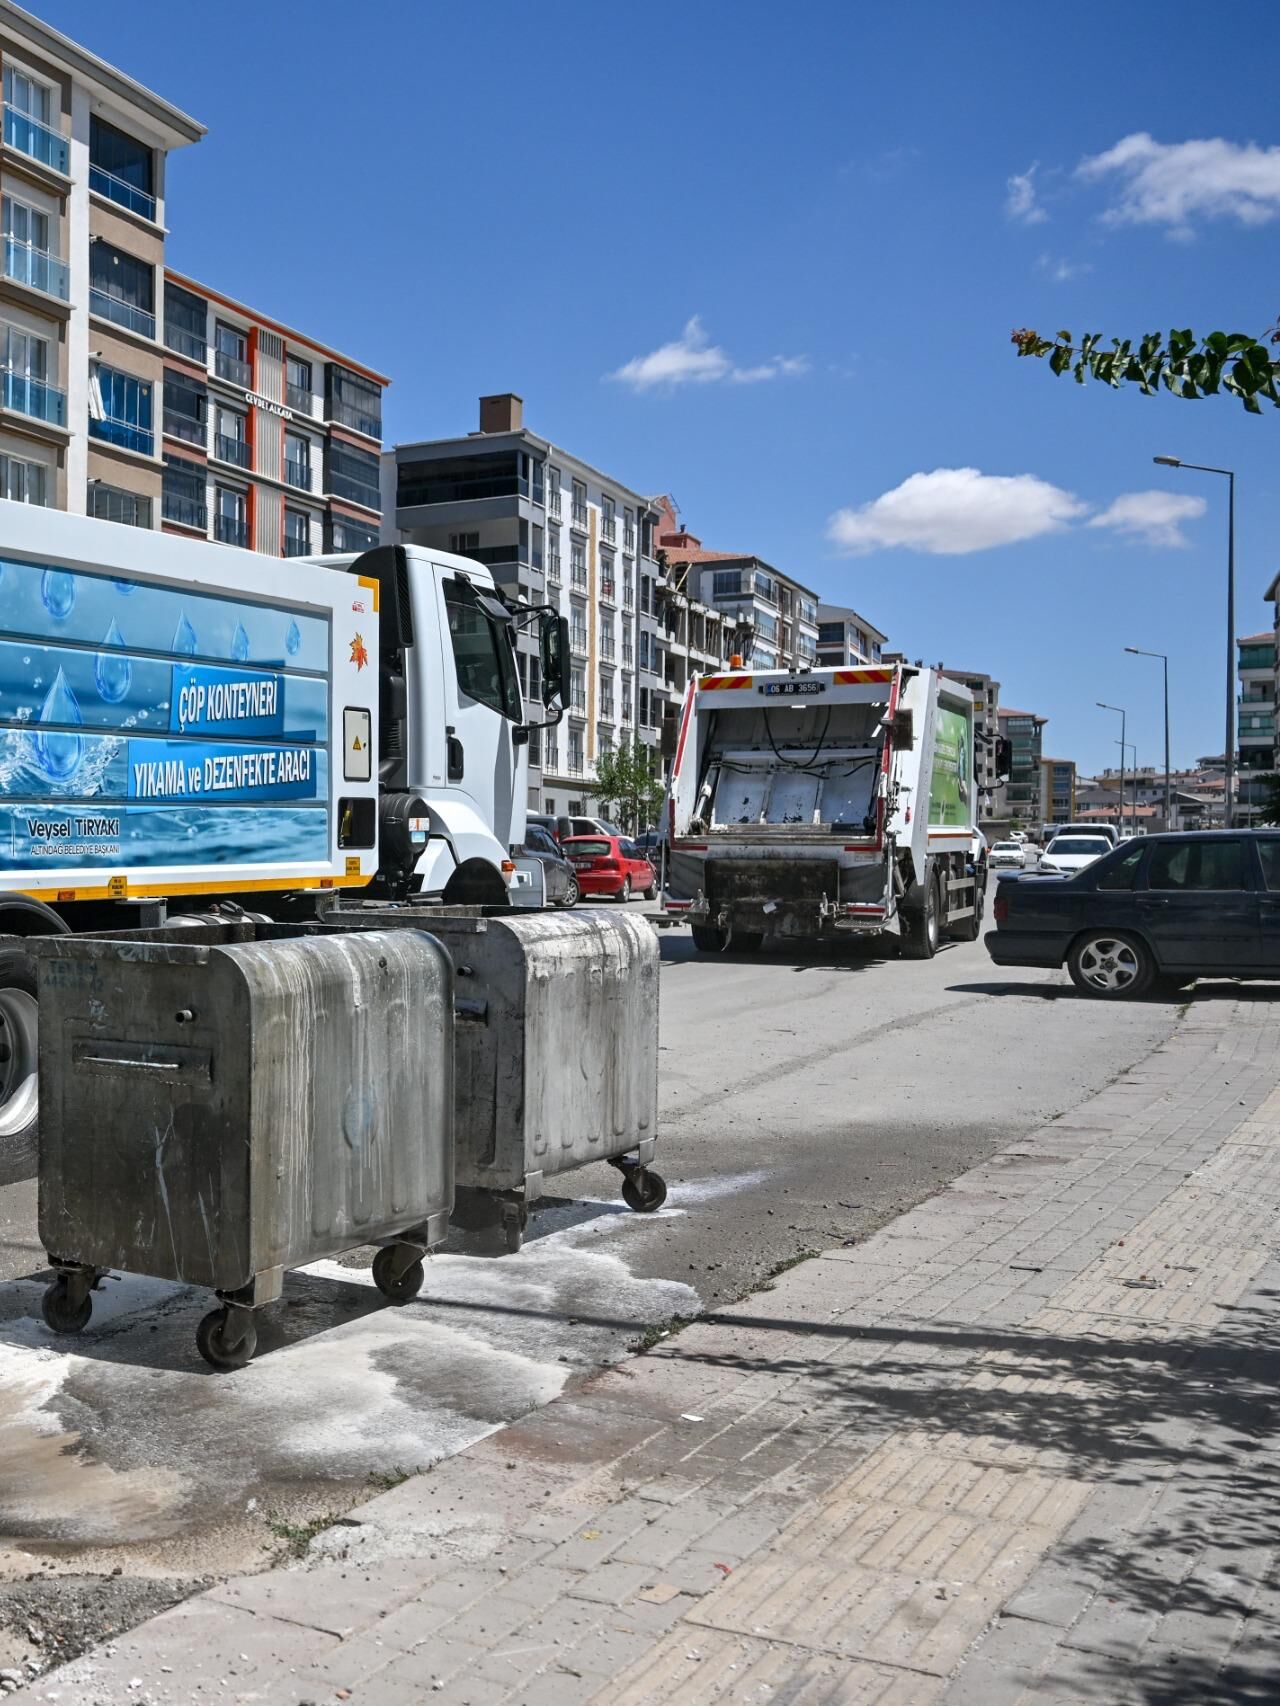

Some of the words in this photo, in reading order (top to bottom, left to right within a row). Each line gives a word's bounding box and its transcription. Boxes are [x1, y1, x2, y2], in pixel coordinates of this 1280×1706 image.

[179, 678, 205, 733] ÇÖP
[207, 675, 278, 721] KONTEYNERİ
[134, 760, 186, 798] YIKAMA
[188, 766, 202, 793] ve
[204, 752, 276, 791] DEZENFEKTE
[277, 749, 311, 784] ARACI
[28, 819, 71, 840] Veysel
[31, 843, 64, 855] ALTINDAĞ
